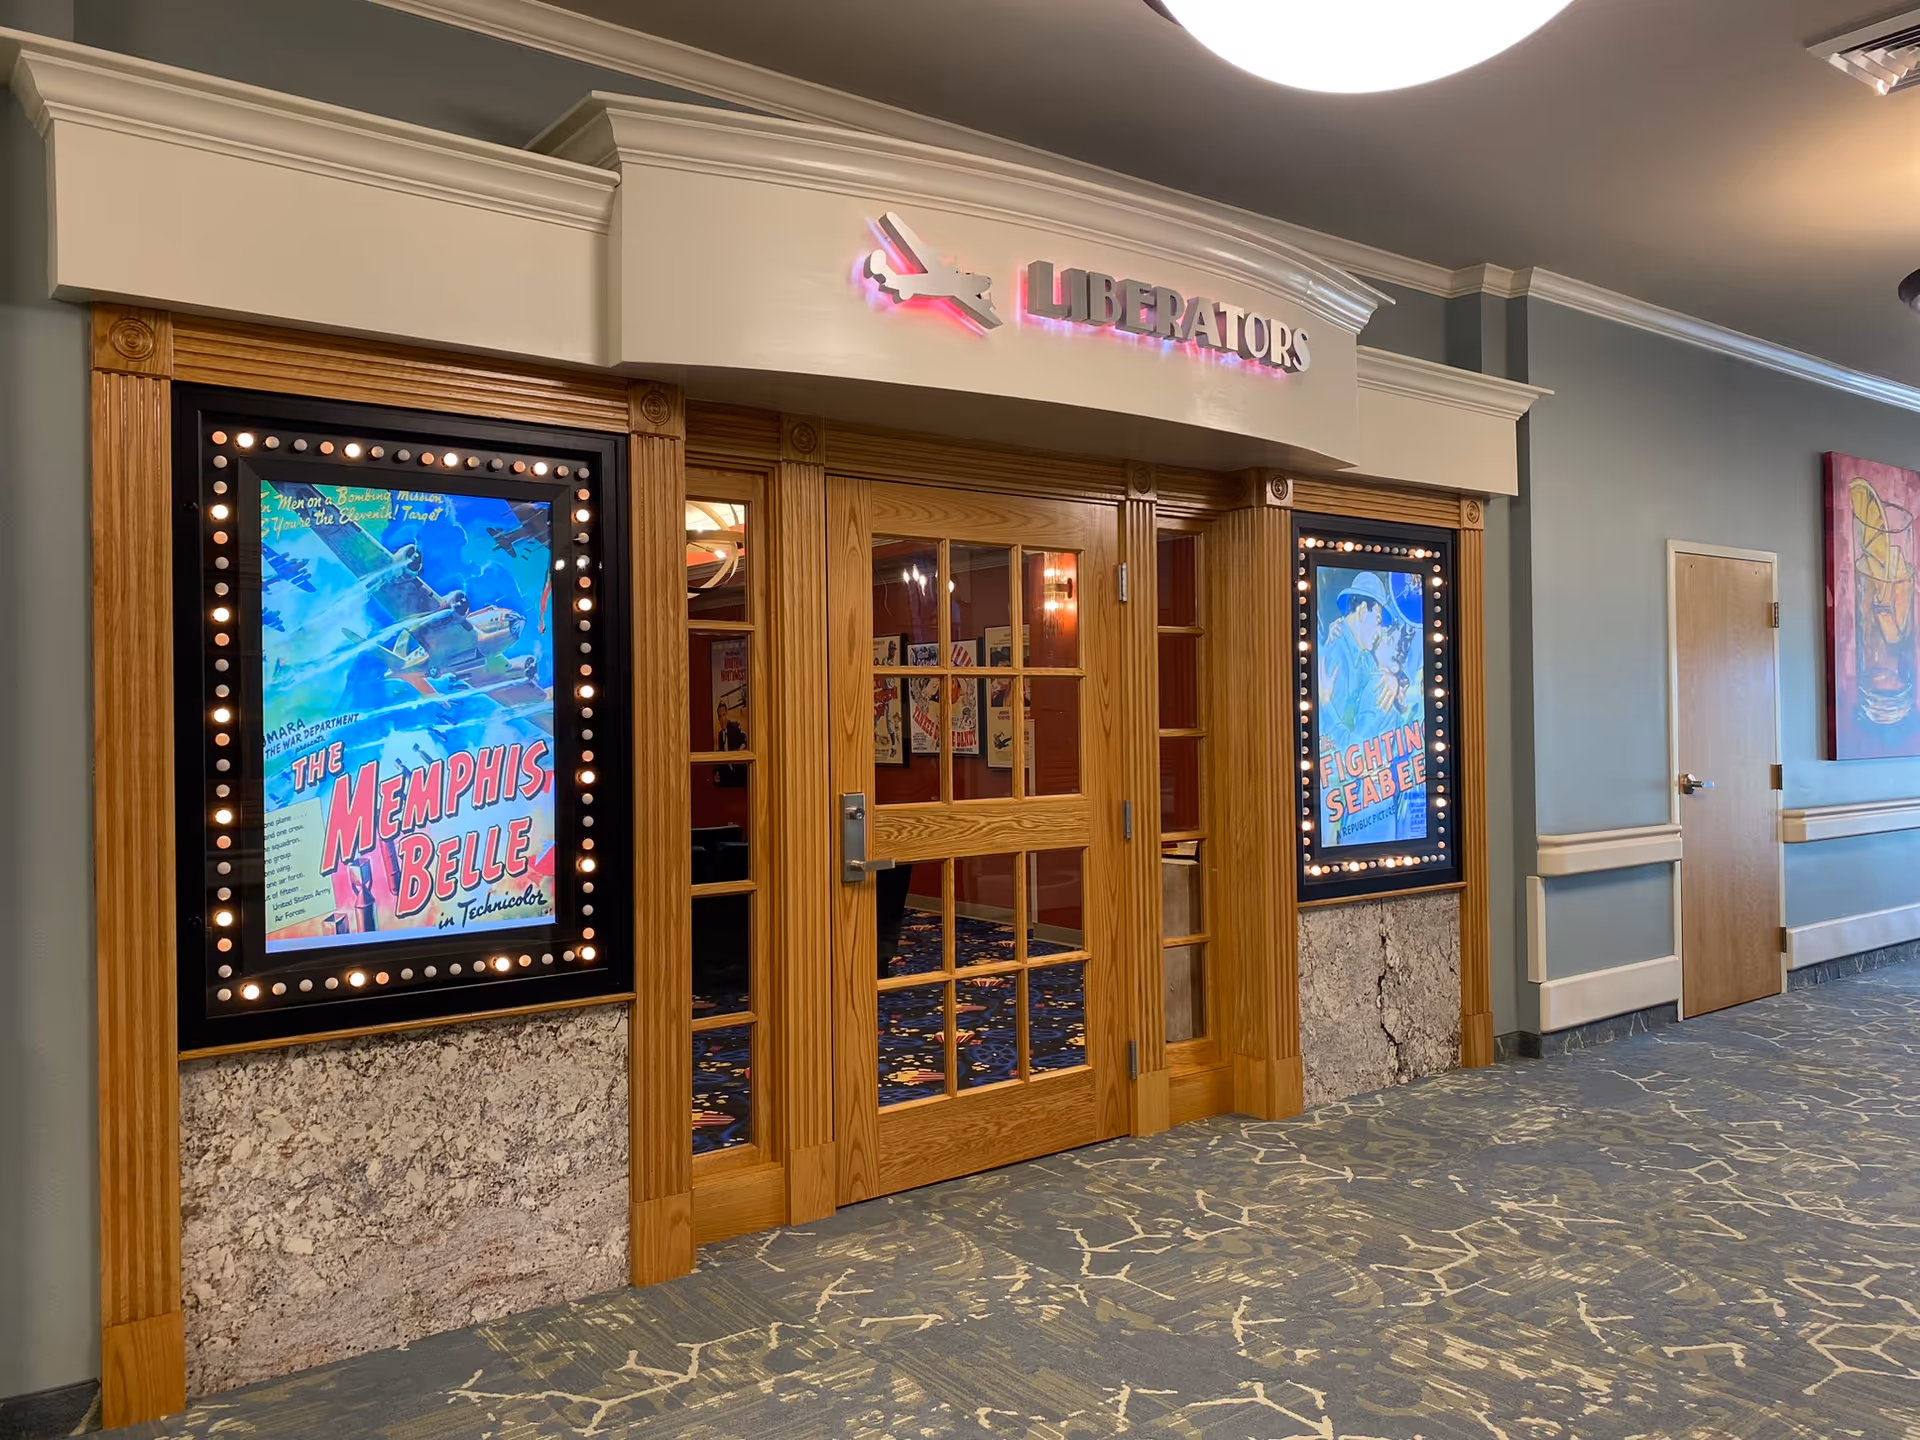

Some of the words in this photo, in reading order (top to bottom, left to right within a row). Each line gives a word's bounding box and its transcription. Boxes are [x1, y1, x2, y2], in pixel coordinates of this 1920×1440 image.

[1026, 260, 1311, 373] LIBERATORS
[273, 494, 305, 511] Men
[307, 497, 322, 508] on
[325, 497, 333, 505] a
[336, 486, 392, 507] Bombing
[396, 490, 444, 504] Mission
[314, 508, 335, 526] the
[339, 504, 399, 525] Eleventh!
[402, 505, 444, 525] Target
[265, 743, 282, 760] THE
[282, 732, 302, 751] WAR
[303, 713, 360, 740] DEPARTMENT
[1319, 719, 1425, 789] FIGHTIN
[291, 740, 345, 793] THE
[1325, 752, 1426, 823] SEABEE
[320, 739, 550, 877] MEMPHIS
[1342, 814, 1372, 837] REPUBLIC
[266, 881, 277, 889] one
[394, 816, 533, 919] BELLE
[272, 898, 295, 911] United
[295, 892, 316, 905] States
[316, 887, 332, 898] Army
[275, 910, 286, 922] Air
[438, 911, 456, 930] in
[457, 884, 548, 928] Technicolor
